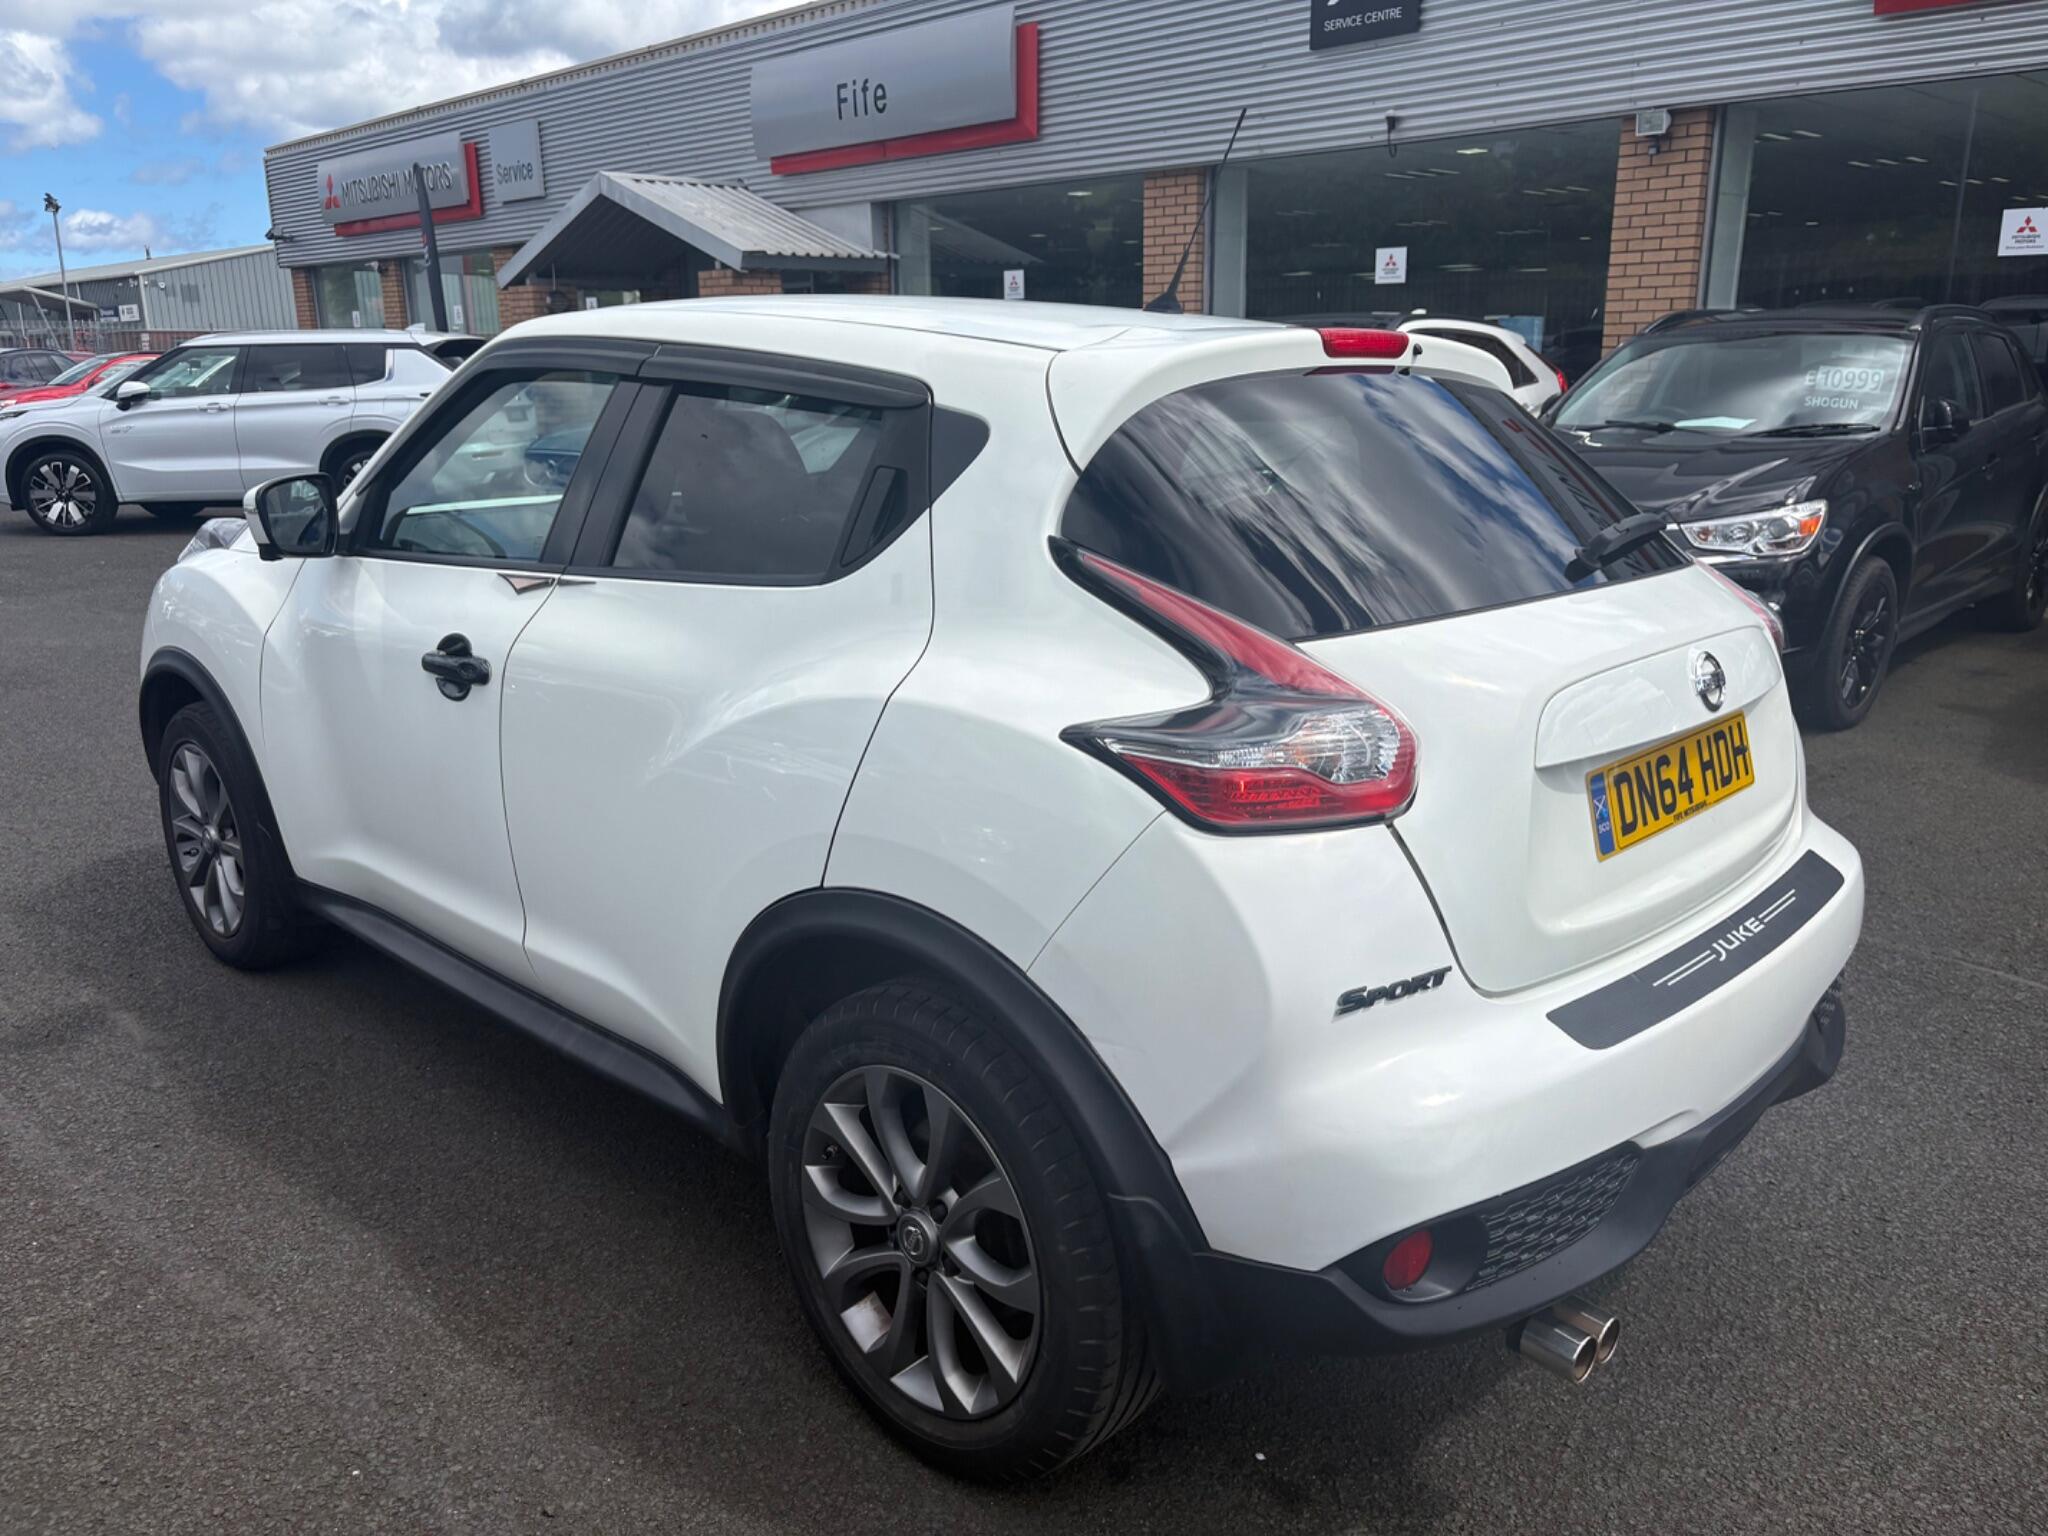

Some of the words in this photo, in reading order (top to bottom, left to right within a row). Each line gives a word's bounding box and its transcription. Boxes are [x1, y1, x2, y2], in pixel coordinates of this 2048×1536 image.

[1323, 14, 1362, 31] SERVICE
[1364, 7, 1402, 24] CENTRE
[837, 78, 887, 120] Fife
[341, 171, 401, 206] MITSUBISHI
[403, 162, 452, 198] MORS
[496, 160, 534, 185] Service
[1804, 396, 1859, 409] SHOGUN
[1613, 745, 1694, 837] DN64
[1696, 721, 1750, 797] HDH
[1711, 916, 1765, 962] JUKE
[1335, 965, 1452, 1016] SPORT
